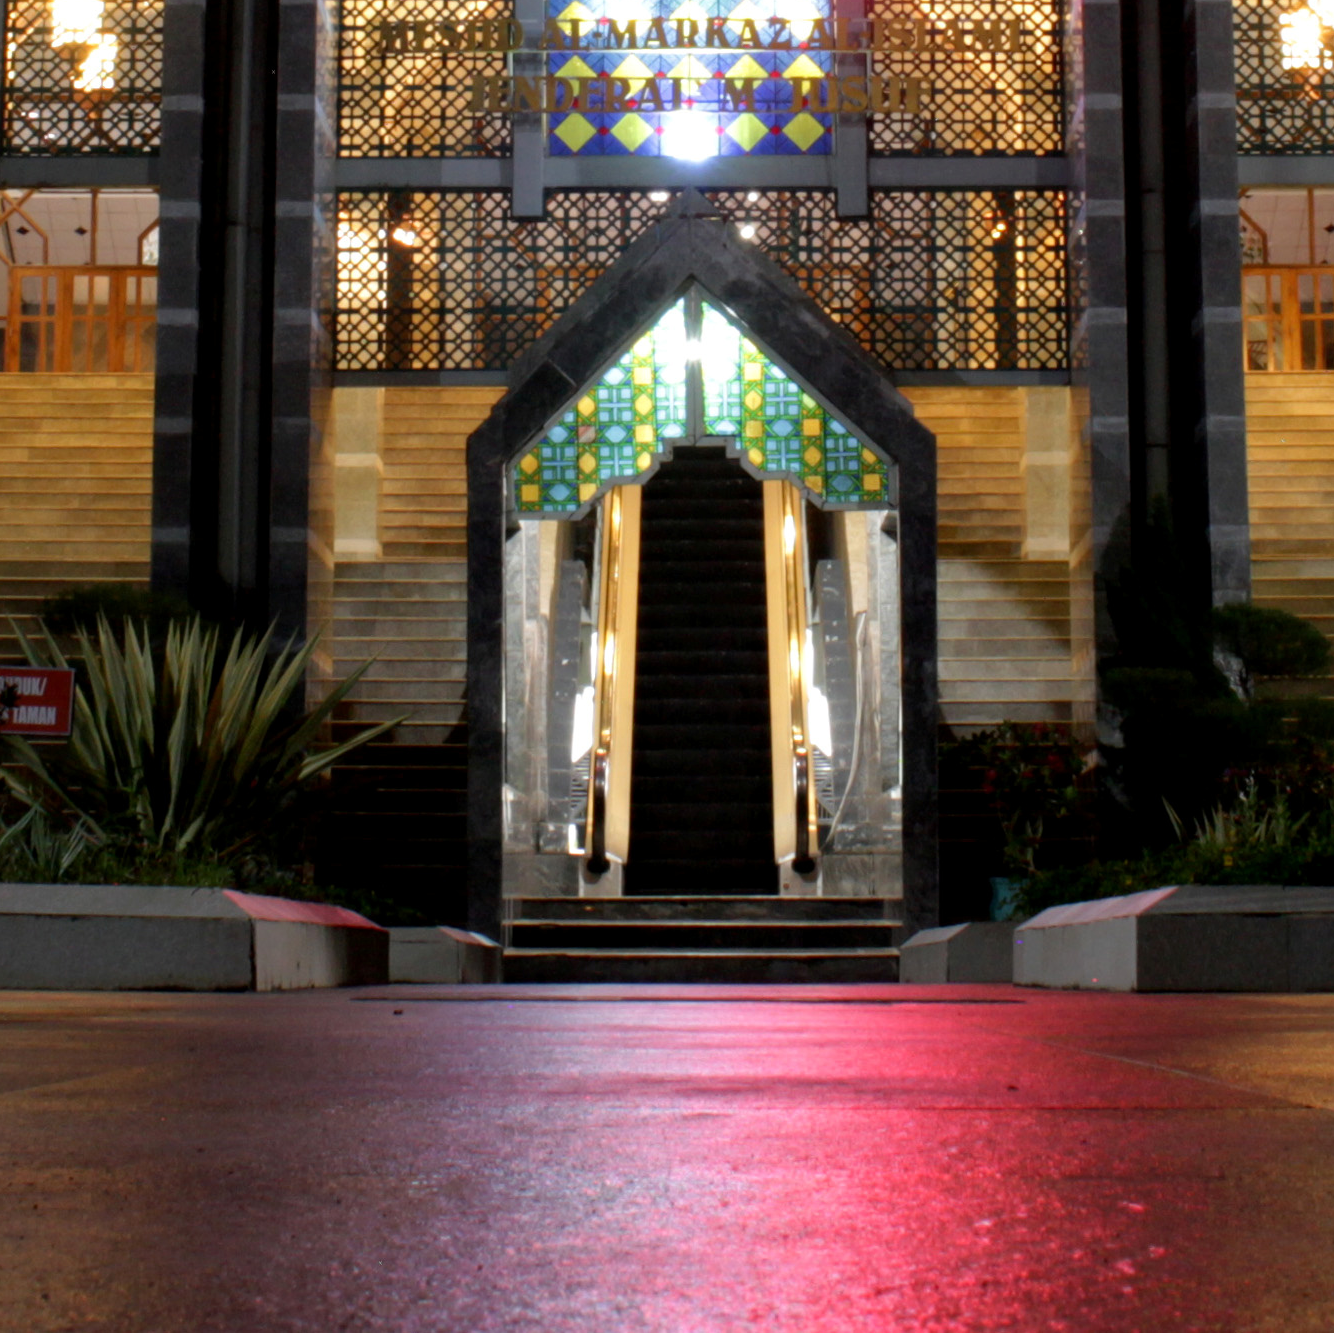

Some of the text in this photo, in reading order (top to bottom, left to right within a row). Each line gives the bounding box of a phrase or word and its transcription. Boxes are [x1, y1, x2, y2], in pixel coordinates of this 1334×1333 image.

[539, 17, 793, 51] AL-MARKAZ
[806, 17, 1021, 52] AL-ISLAMI
[468, 76, 696, 112] JENDERAL
[788, 75, 932, 113] JUSUF
[12, 705, 57, 726] TAMAN
